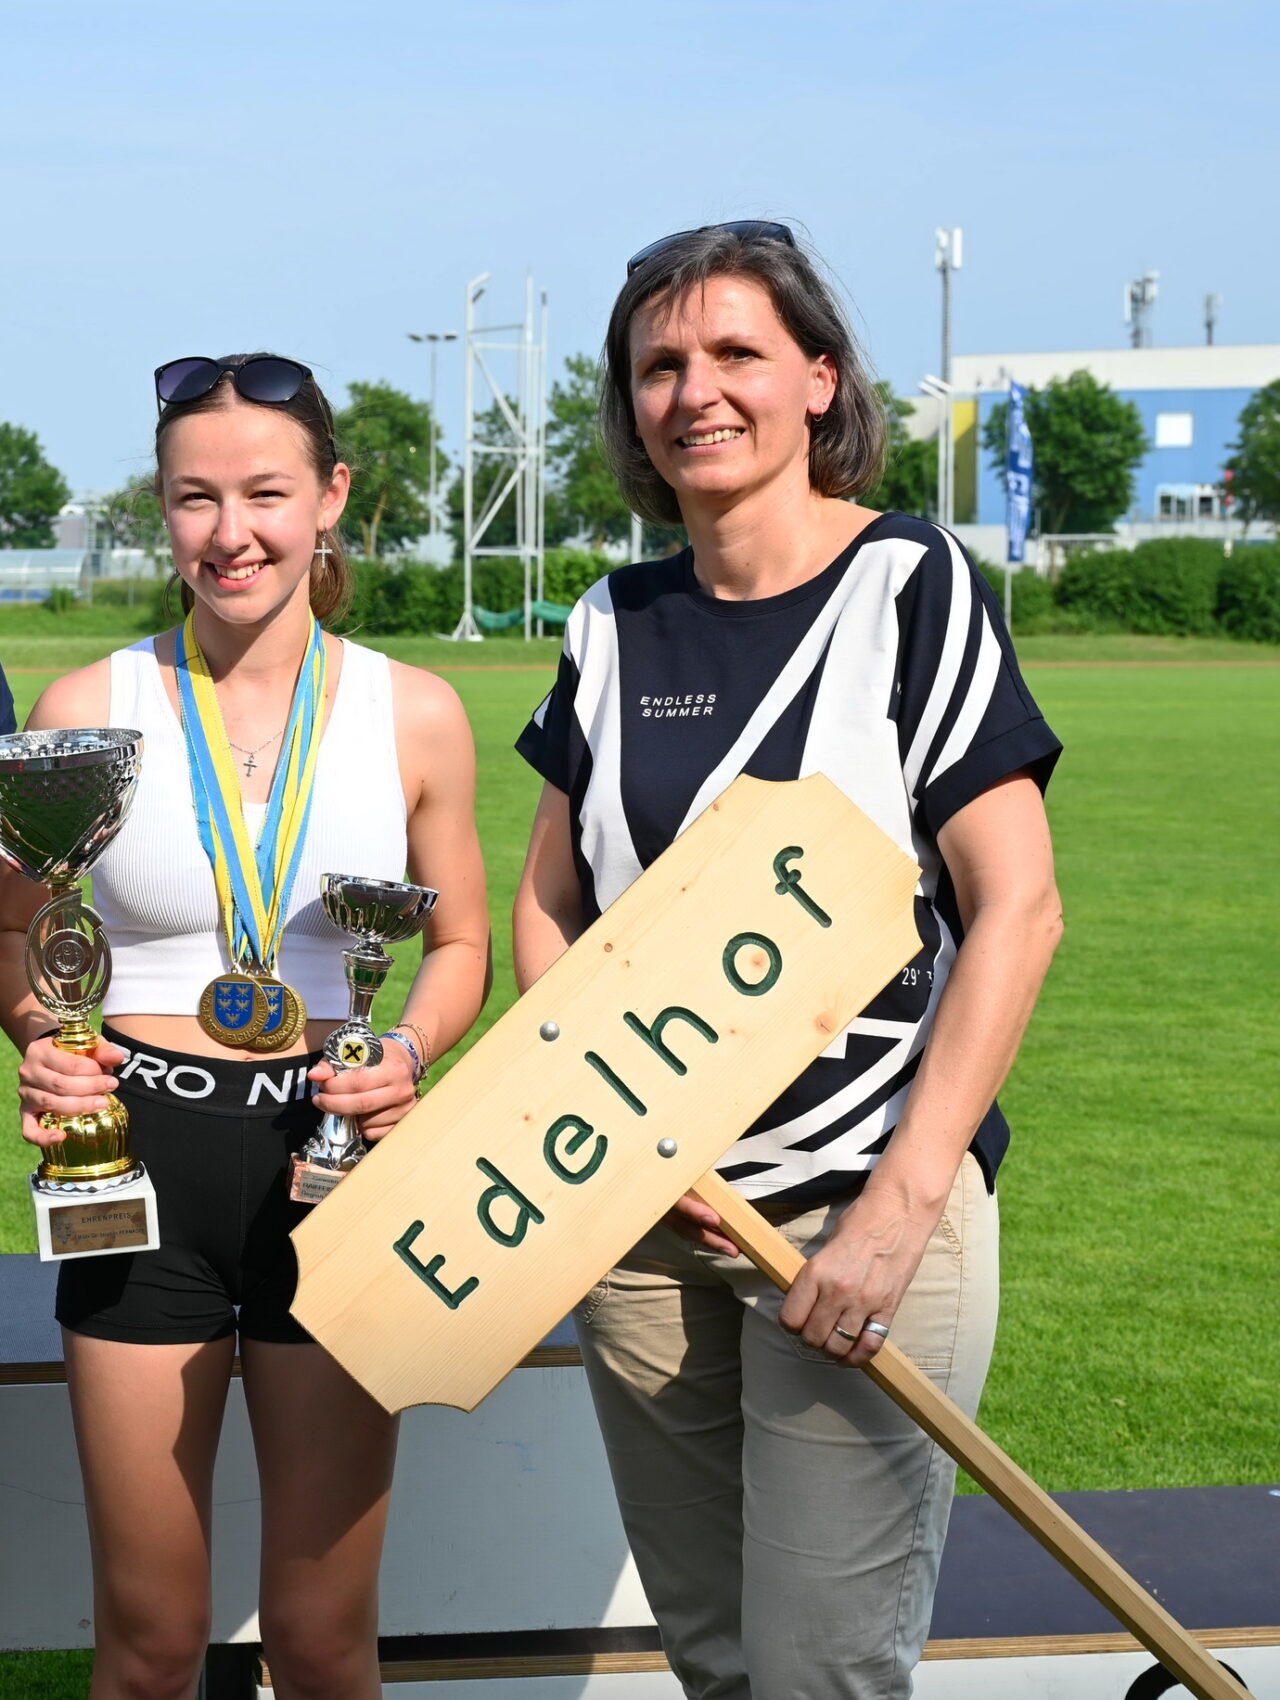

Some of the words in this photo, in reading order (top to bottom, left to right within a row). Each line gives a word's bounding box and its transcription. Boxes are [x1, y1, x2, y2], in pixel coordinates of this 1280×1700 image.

[639, 693, 717, 706] ENDLESS
[642, 706, 714, 718] SUMMER
[393, 845, 833, 1310] Edelhof
[246, 1066, 321, 1106] NI
[81, 1212, 130, 1224] EHRENPREIS
